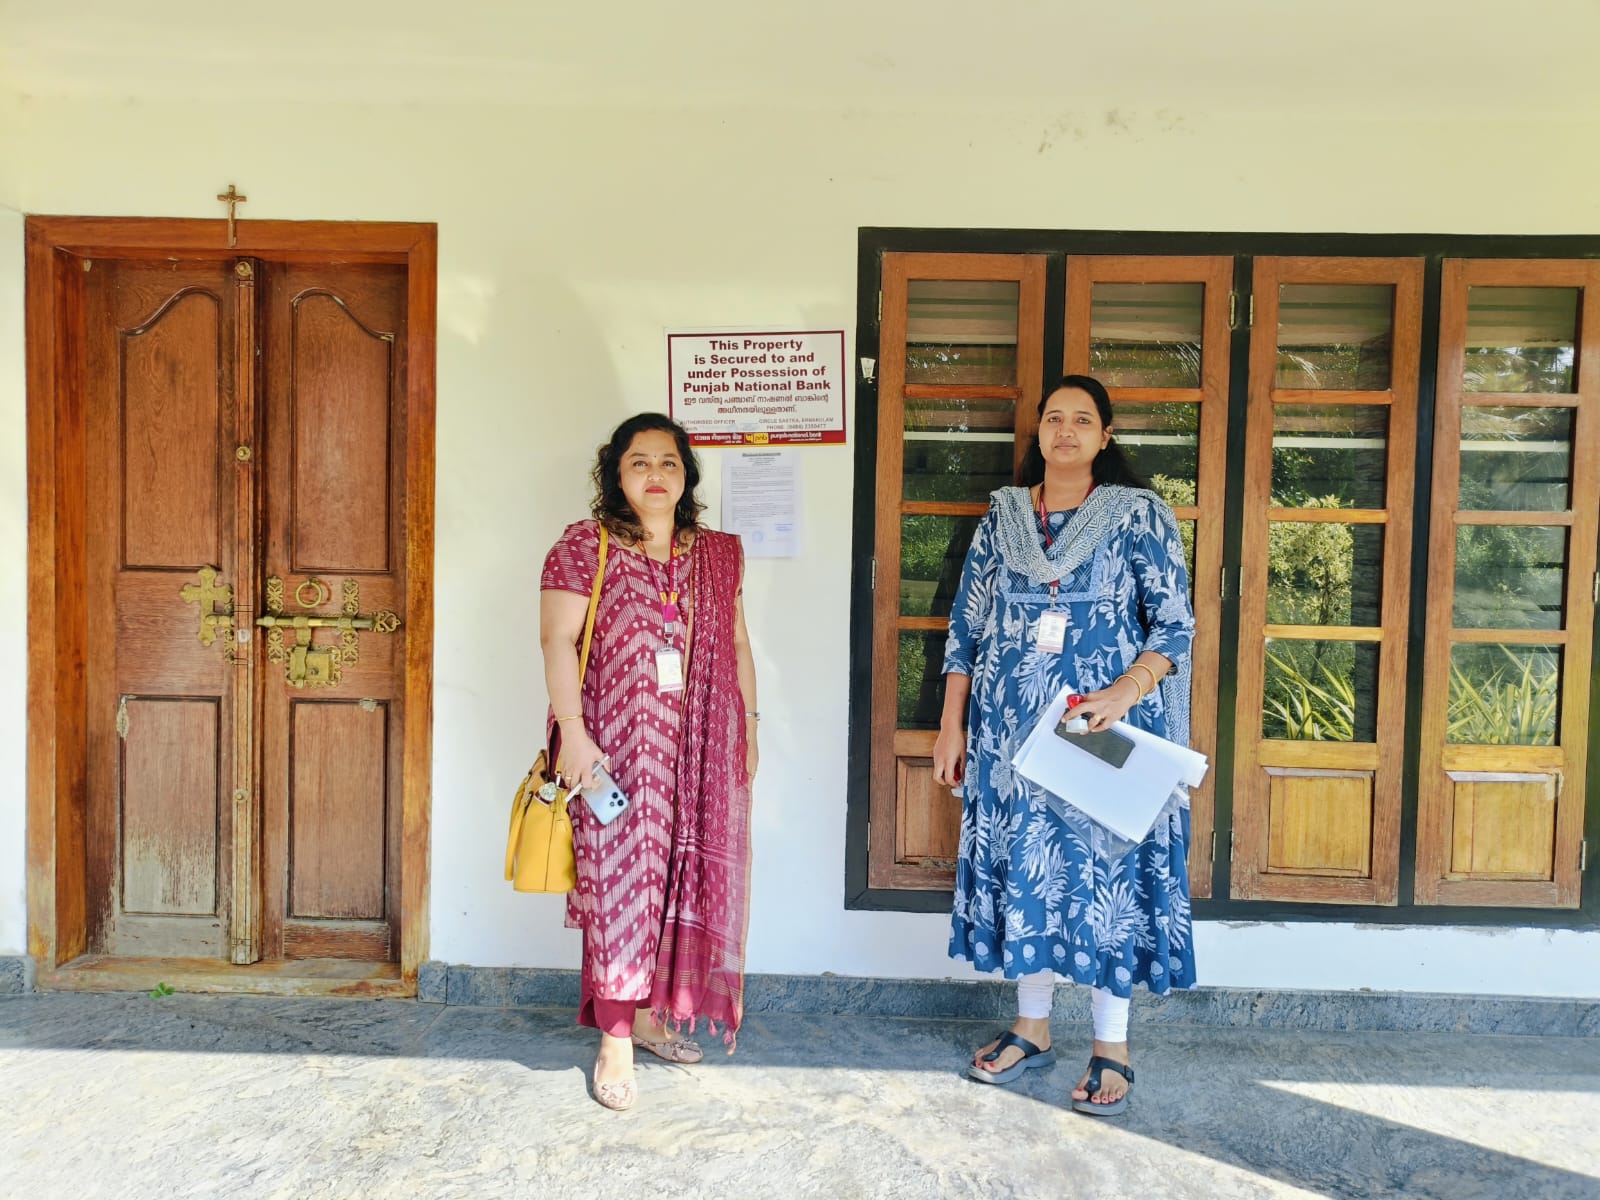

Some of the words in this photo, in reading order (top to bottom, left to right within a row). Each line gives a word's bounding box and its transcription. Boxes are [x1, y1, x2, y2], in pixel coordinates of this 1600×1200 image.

[709, 340, 739, 351] This
[743, 339, 803, 352] Property
[694, 355, 706, 365] is
[710, 353, 767, 365] Secured
[771, 353, 785, 364] to
[789, 352, 815, 363] and
[687, 368, 727, 379] under
[731, 366, 808, 379] Possession
[812, 366, 827, 377] of
[683, 382, 730, 395] Punjab
[734, 380, 792, 392] National
[796, 380, 831, 391] Bank
[683, 397, 697, 405] ഈ
